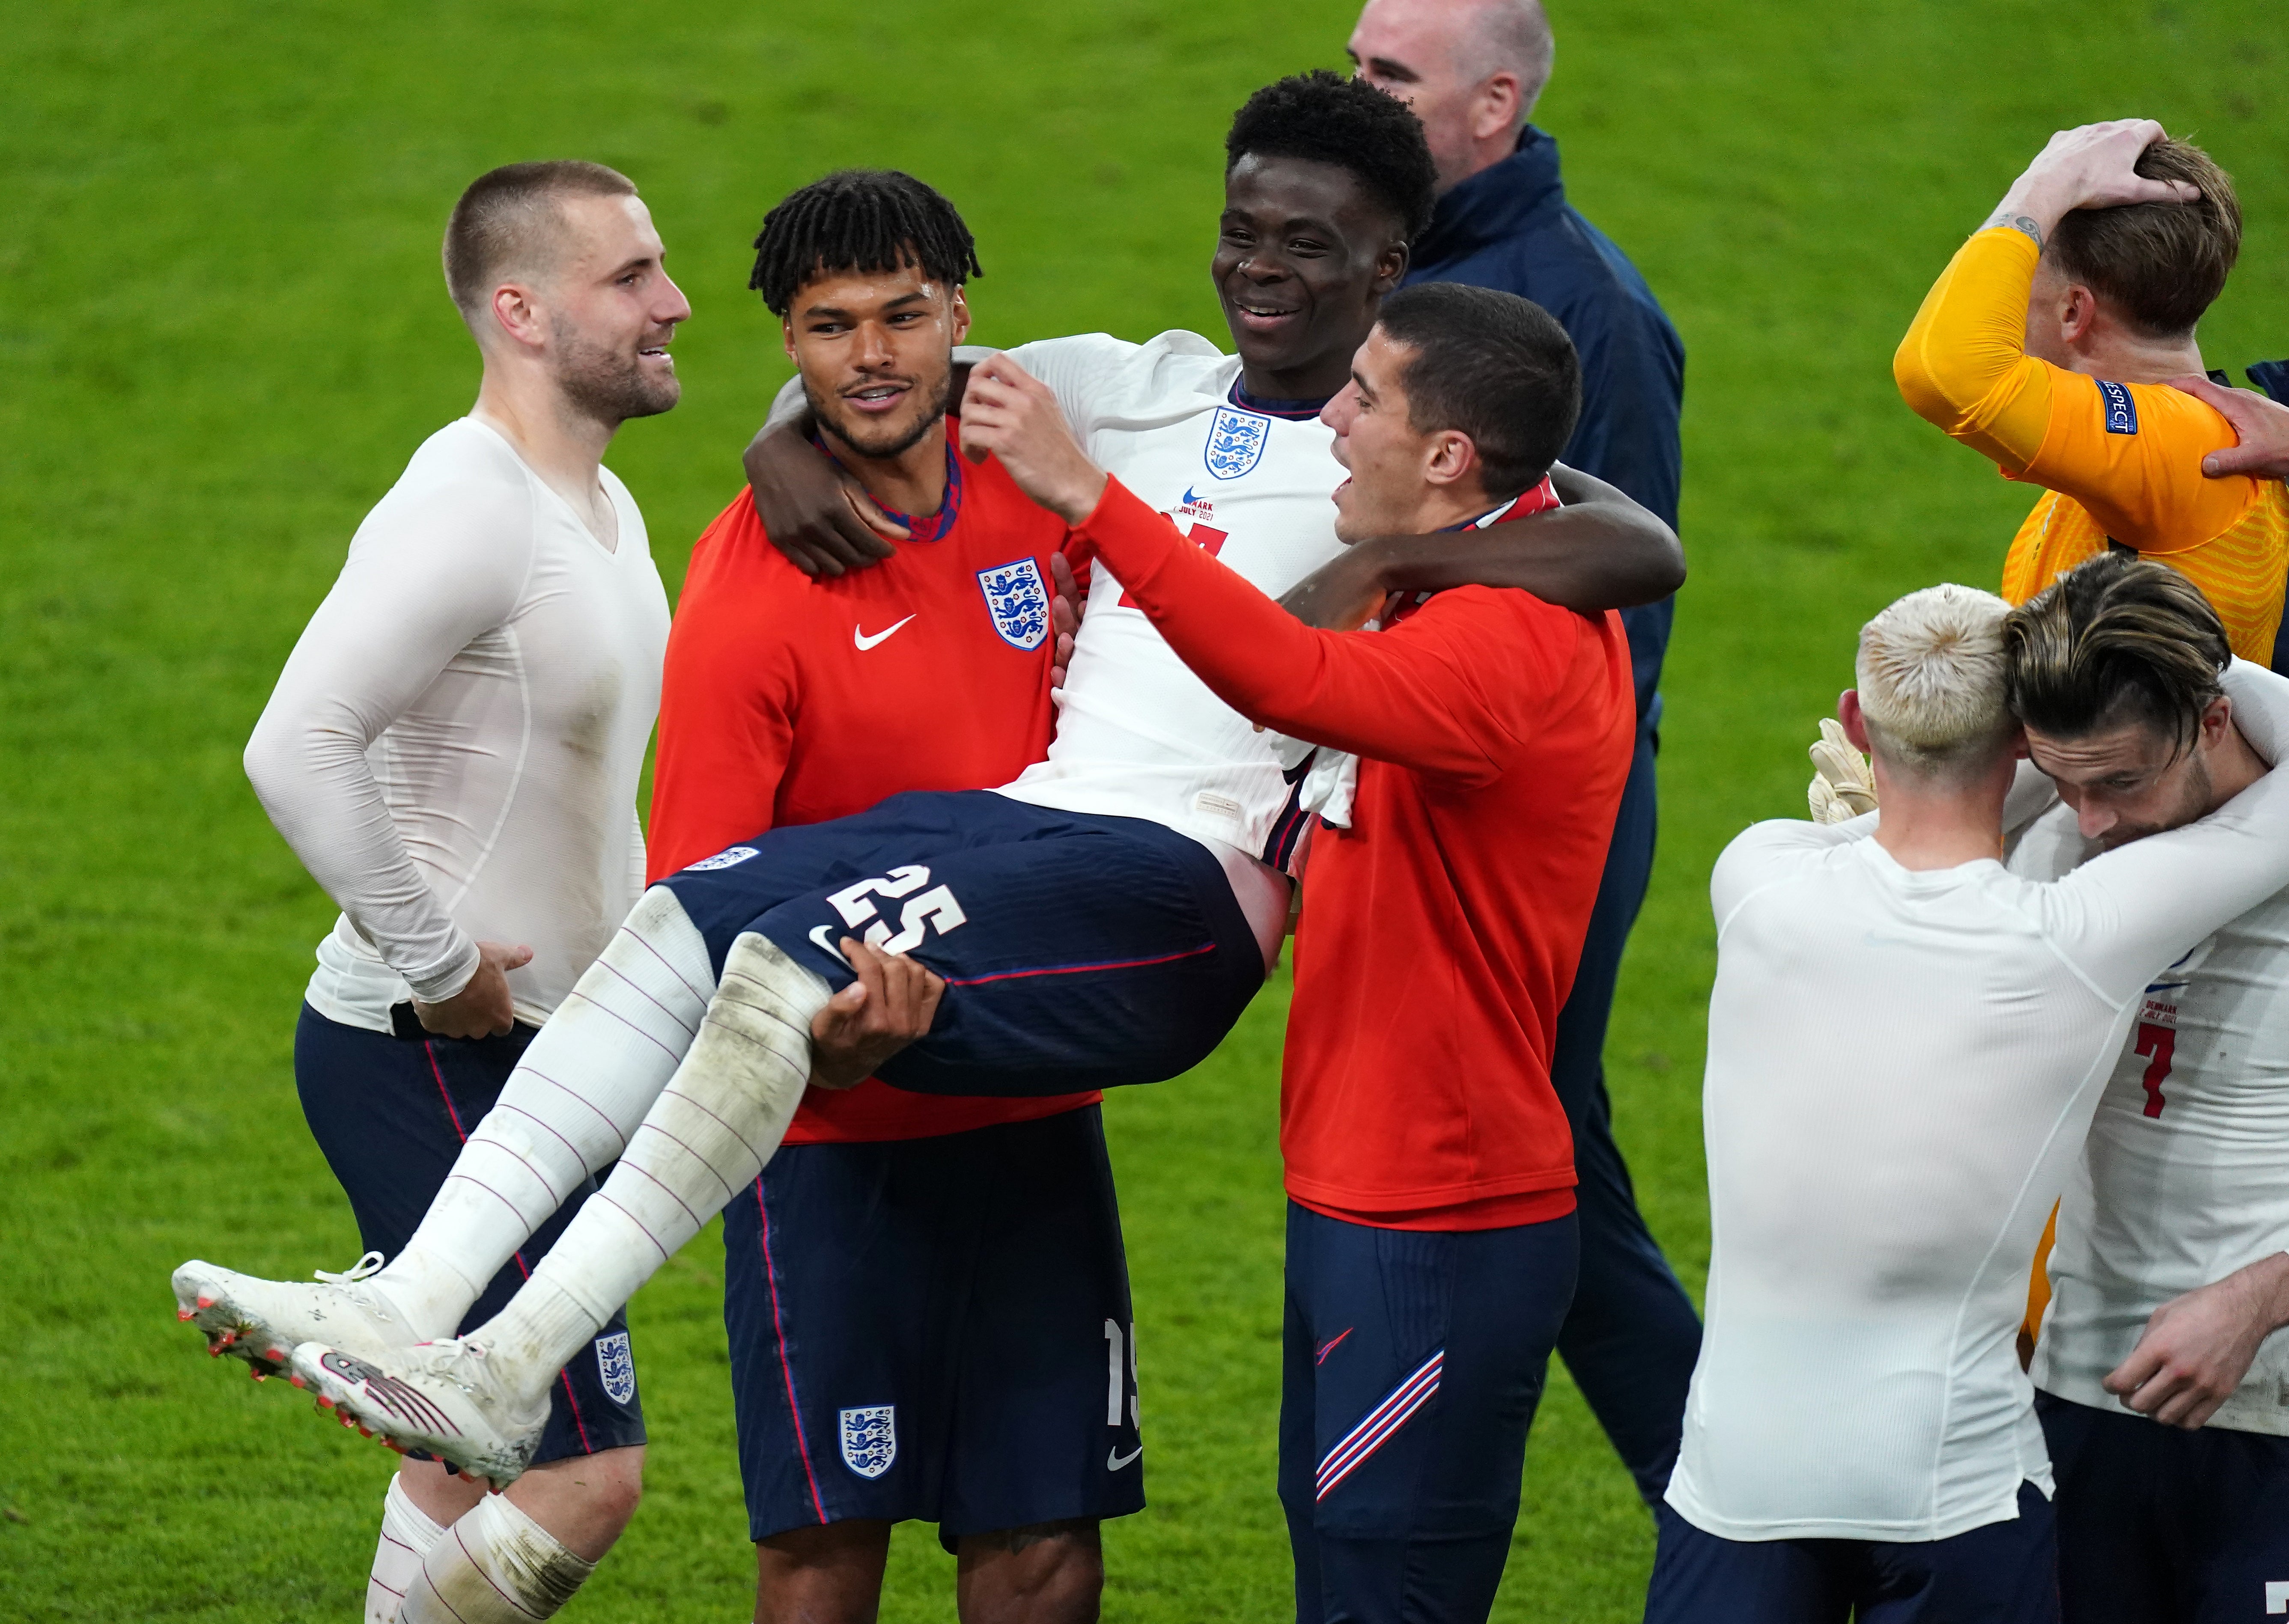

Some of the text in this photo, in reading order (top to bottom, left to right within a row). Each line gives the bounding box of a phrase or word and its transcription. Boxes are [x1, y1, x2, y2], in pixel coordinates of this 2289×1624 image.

[1179, 506, 1196, 516] JULY
[1199, 511, 1213, 521] 2021
[1187, 500, 1213, 511] MARK
[826, 865, 967, 956] 25
[2134, 1021, 2176, 1119] 7
